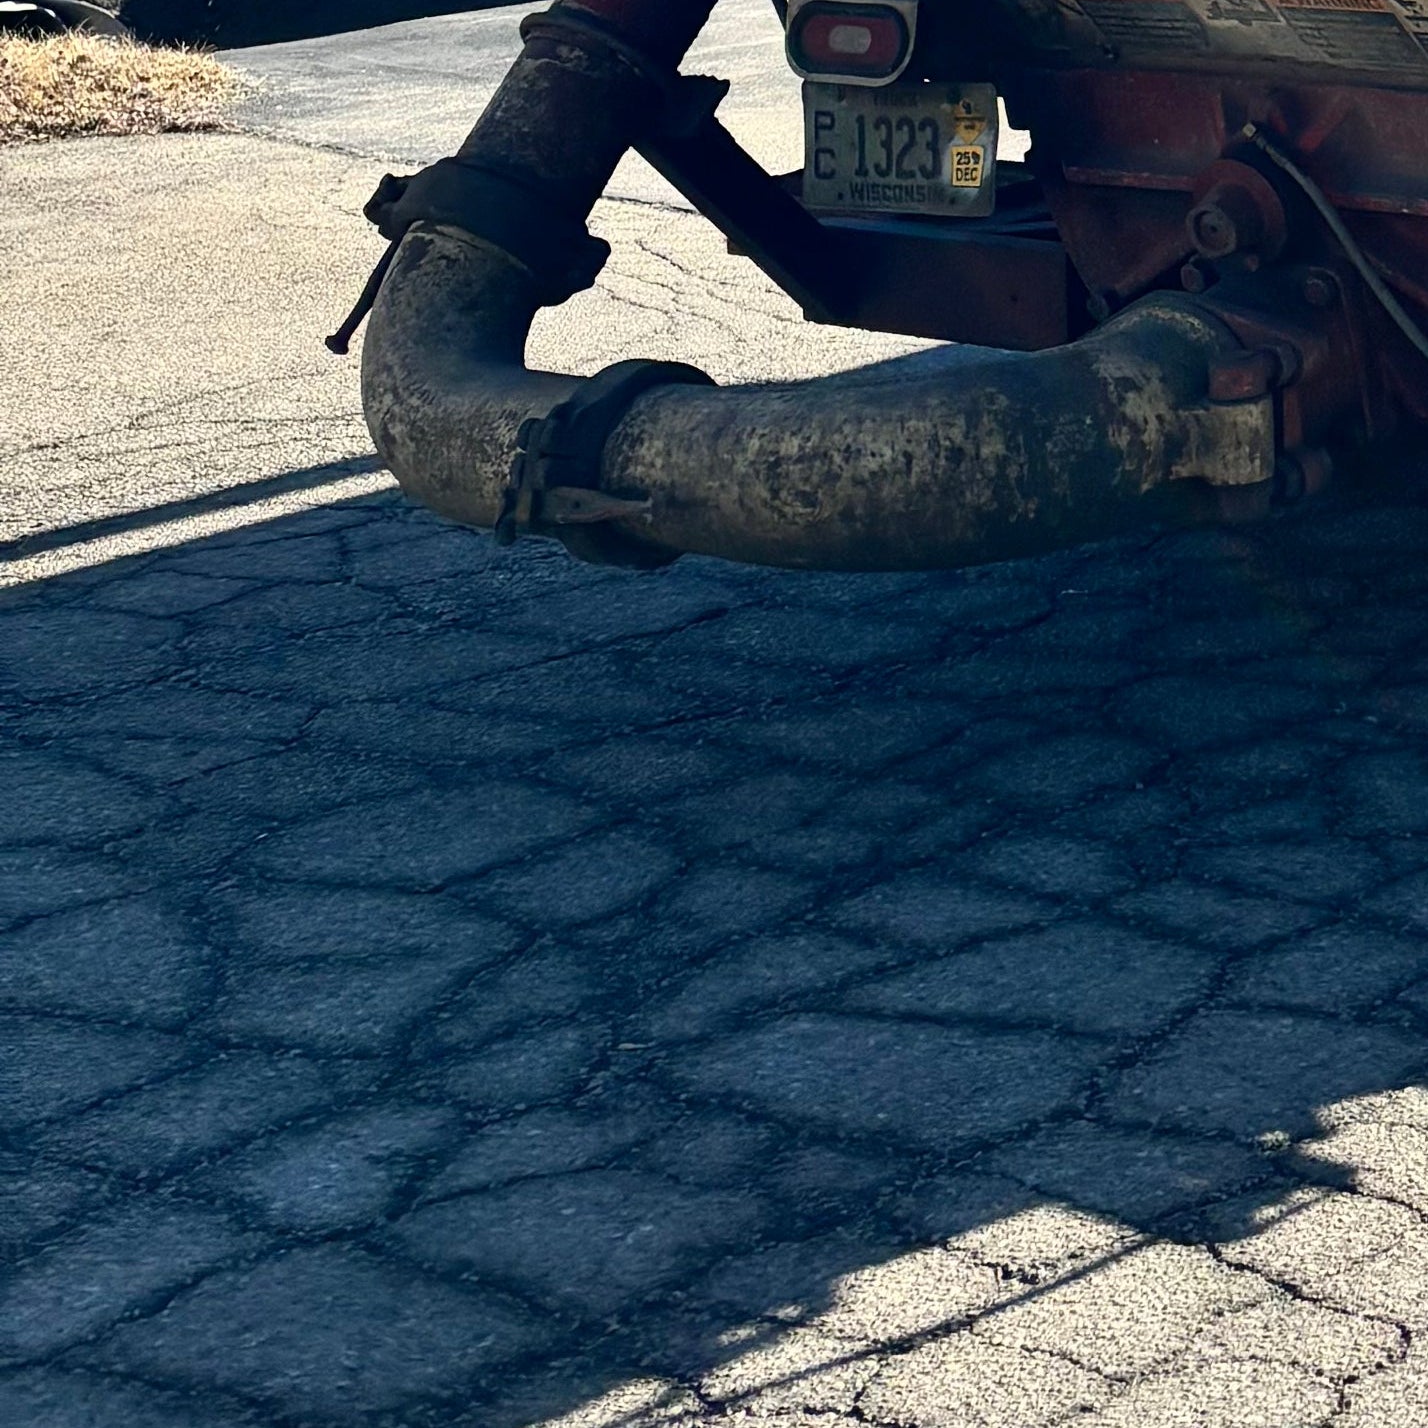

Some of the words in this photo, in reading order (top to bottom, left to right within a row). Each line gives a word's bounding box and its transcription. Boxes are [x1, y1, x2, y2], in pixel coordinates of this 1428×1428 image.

[854, 114, 943, 181] 1323
[955, 167, 979, 182] DEC
[849, 181, 946, 205] WISCONSIN
